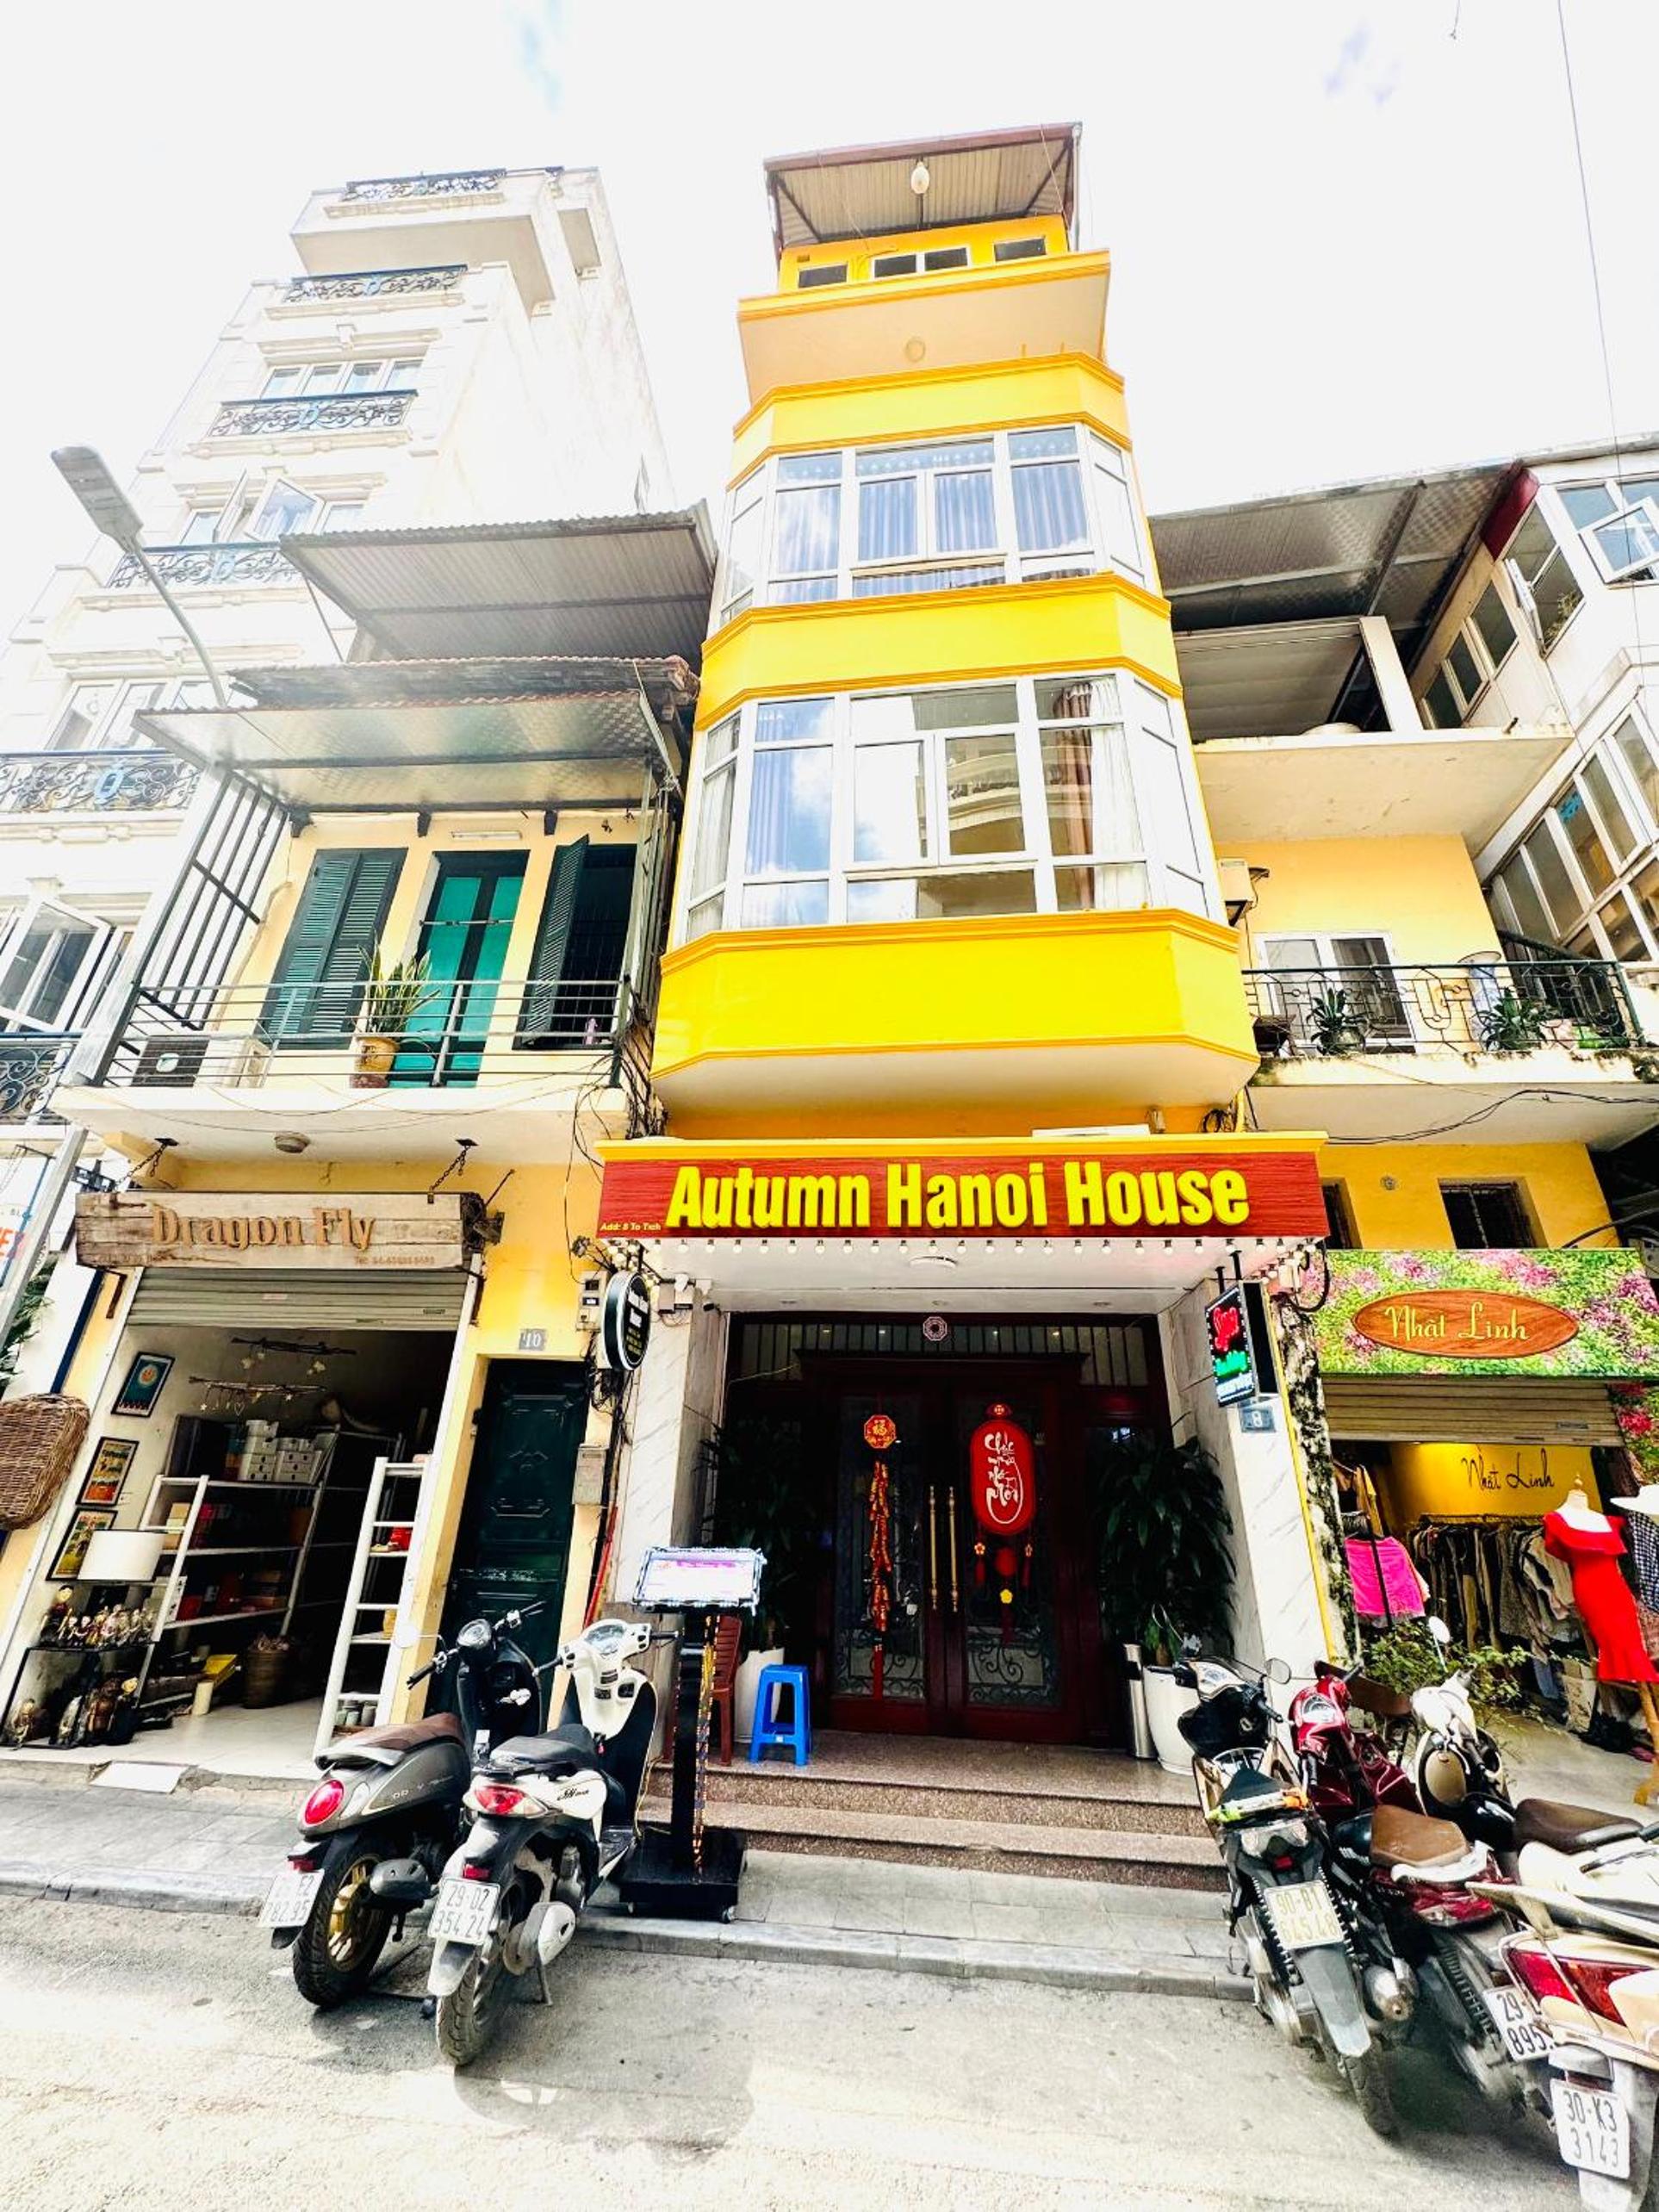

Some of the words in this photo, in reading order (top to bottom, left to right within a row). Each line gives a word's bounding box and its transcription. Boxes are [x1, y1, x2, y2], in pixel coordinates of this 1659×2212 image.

[666, 1165, 871, 1228] Autumn
[886, 1163, 1048, 1228] Hanoi
[1064, 1161, 1250, 1227] House
[152, 1207, 306, 1251] Dragon
[313, 1207, 376, 1252] Fly
[1457, 1302, 1530, 1340] Linh
[1252, 1410, 1264, 1428] 8
[1506, 1448, 1554, 1488] Linh
[1570, 2127, 1619, 2167] 3143
